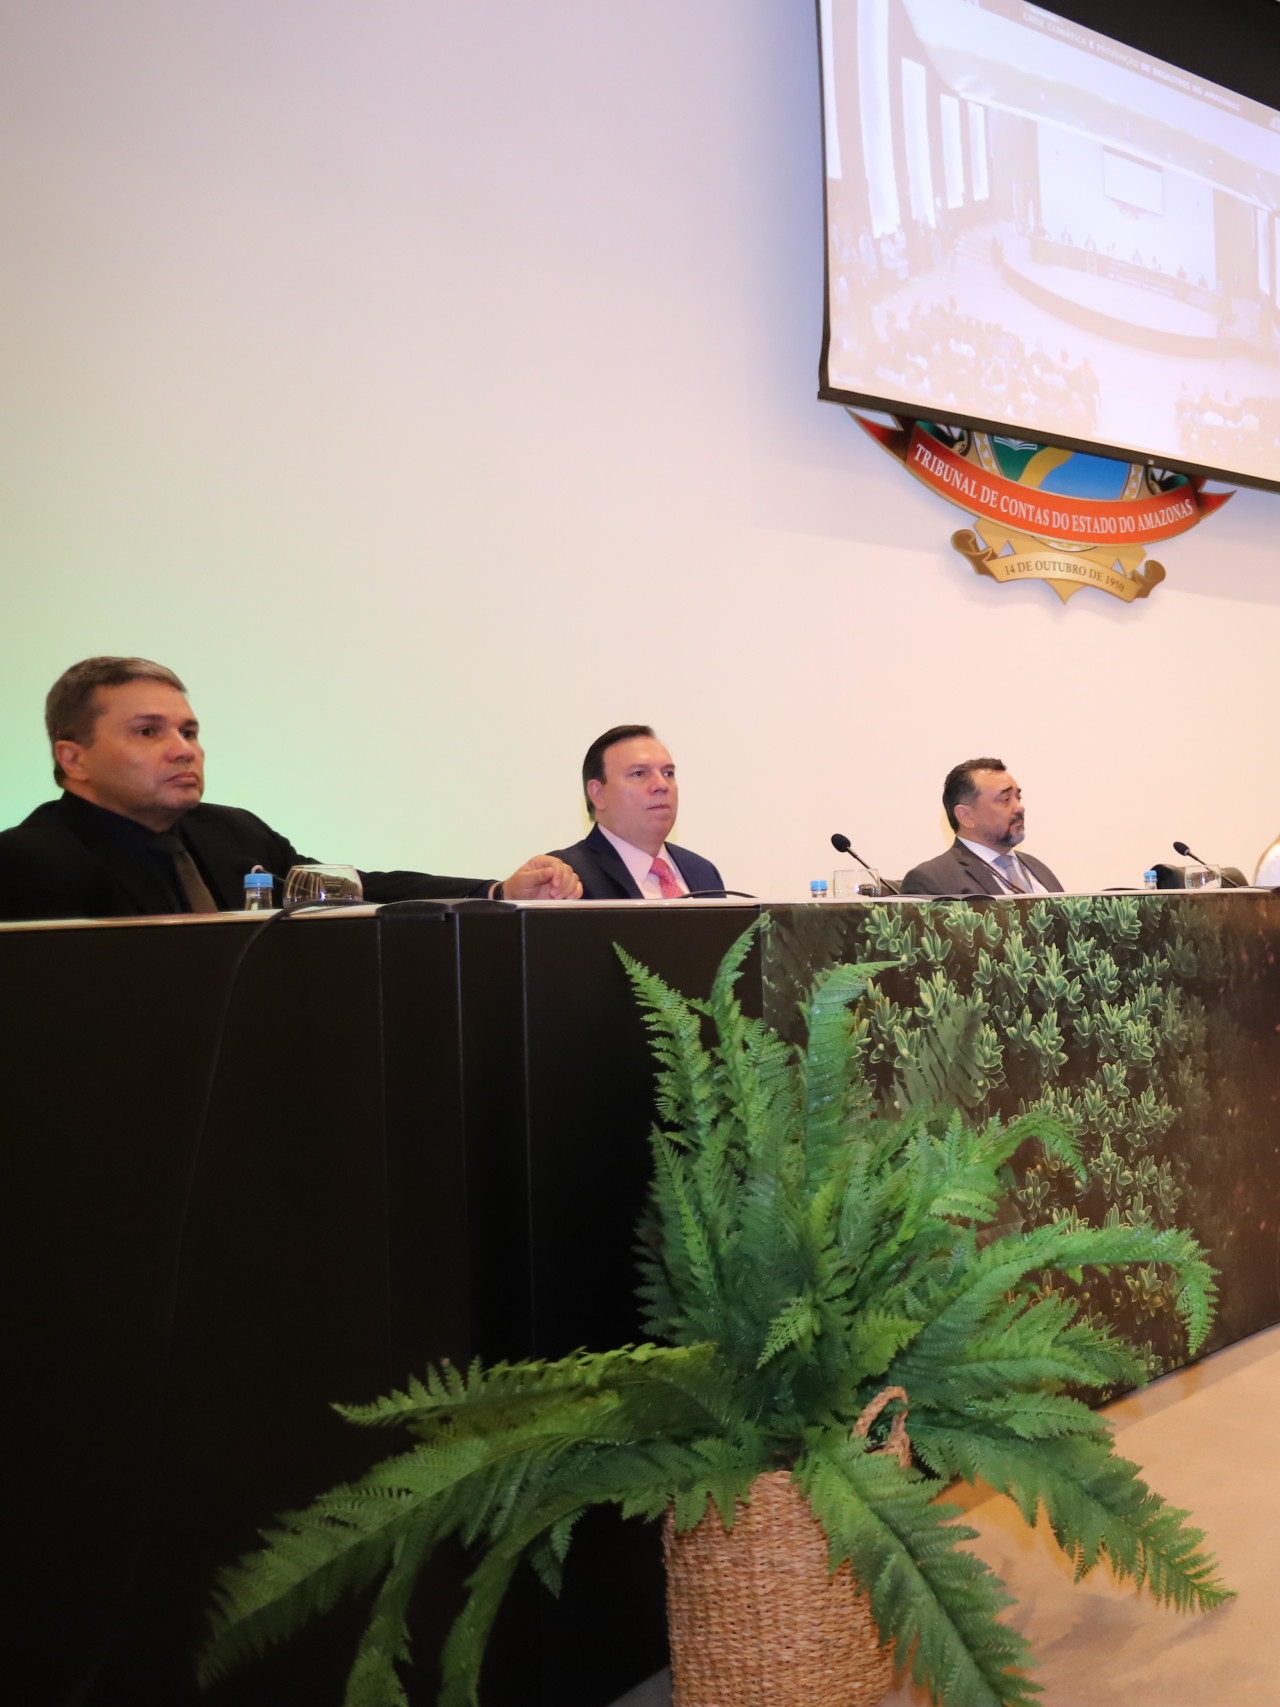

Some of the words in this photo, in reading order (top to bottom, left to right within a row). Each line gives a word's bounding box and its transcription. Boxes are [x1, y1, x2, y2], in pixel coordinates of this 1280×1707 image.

[914, 443, 978, 499] TRIBUNAL
[979, 485, 999, 508] DE
[1000, 495, 1050, 527] CONTAS
[1052, 510, 1070, 531] DO
[1071, 515, 1117, 534] ESTADO
[1119, 516, 1136, 533] DO
[1138, 499, 1194, 531] AMAZONAS
[1004, 564, 1016, 576] 14
[1017, 561, 1033, 573] DE
[1035, 560, 1087, 576] OUTUBRO
[1088, 568, 1104, 582] DE
[1105, 575, 1125, 592] 1950
